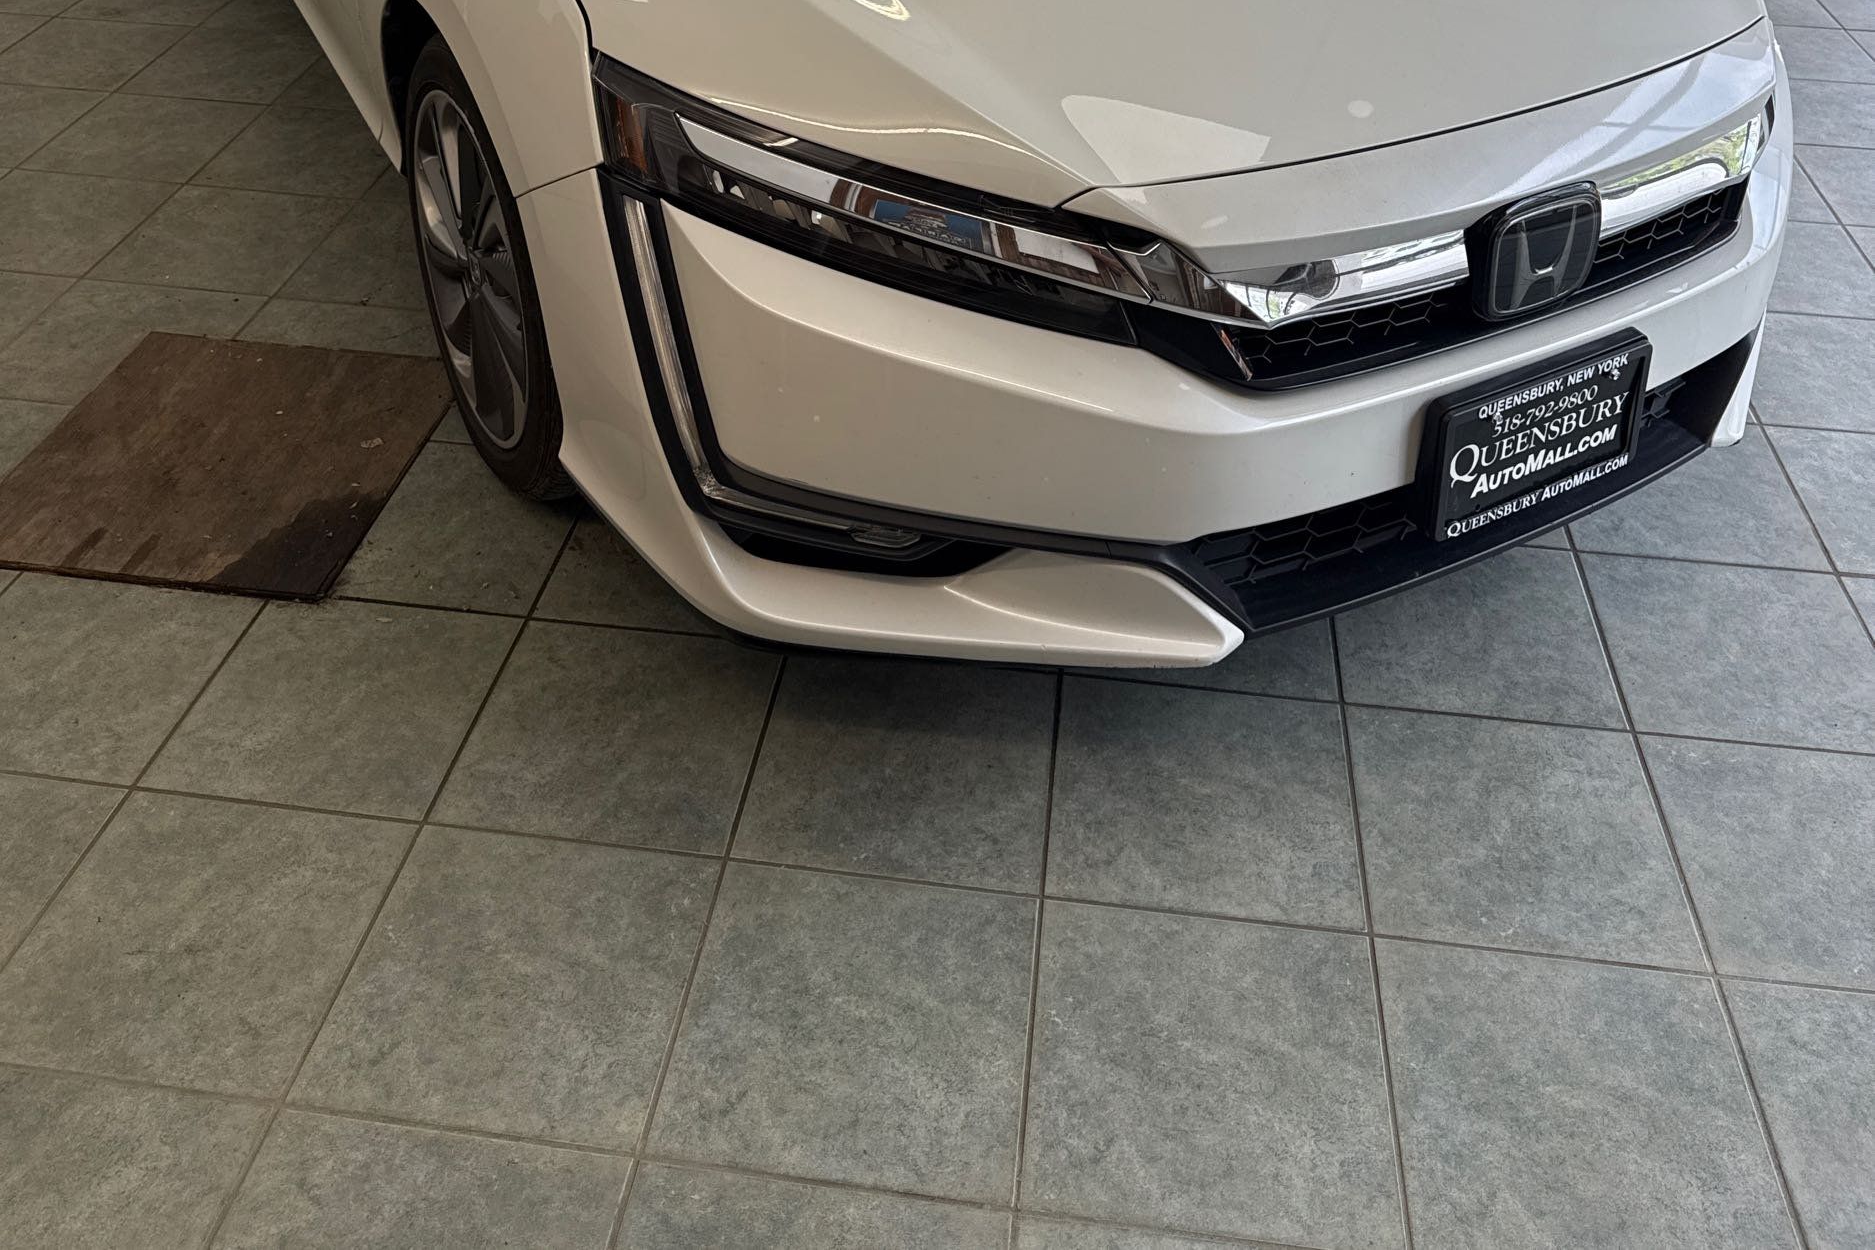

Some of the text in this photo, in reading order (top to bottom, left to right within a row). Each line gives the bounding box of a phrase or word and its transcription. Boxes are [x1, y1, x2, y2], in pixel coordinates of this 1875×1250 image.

[1478, 353, 1629, 419] QUEENSBURY, NEW YORK
[1492, 385, 1599, 438] 518-792-9800
[1450, 392, 1629, 488] QUEENSBURY
[1446, 490, 1541, 538] QUEENSBURY
